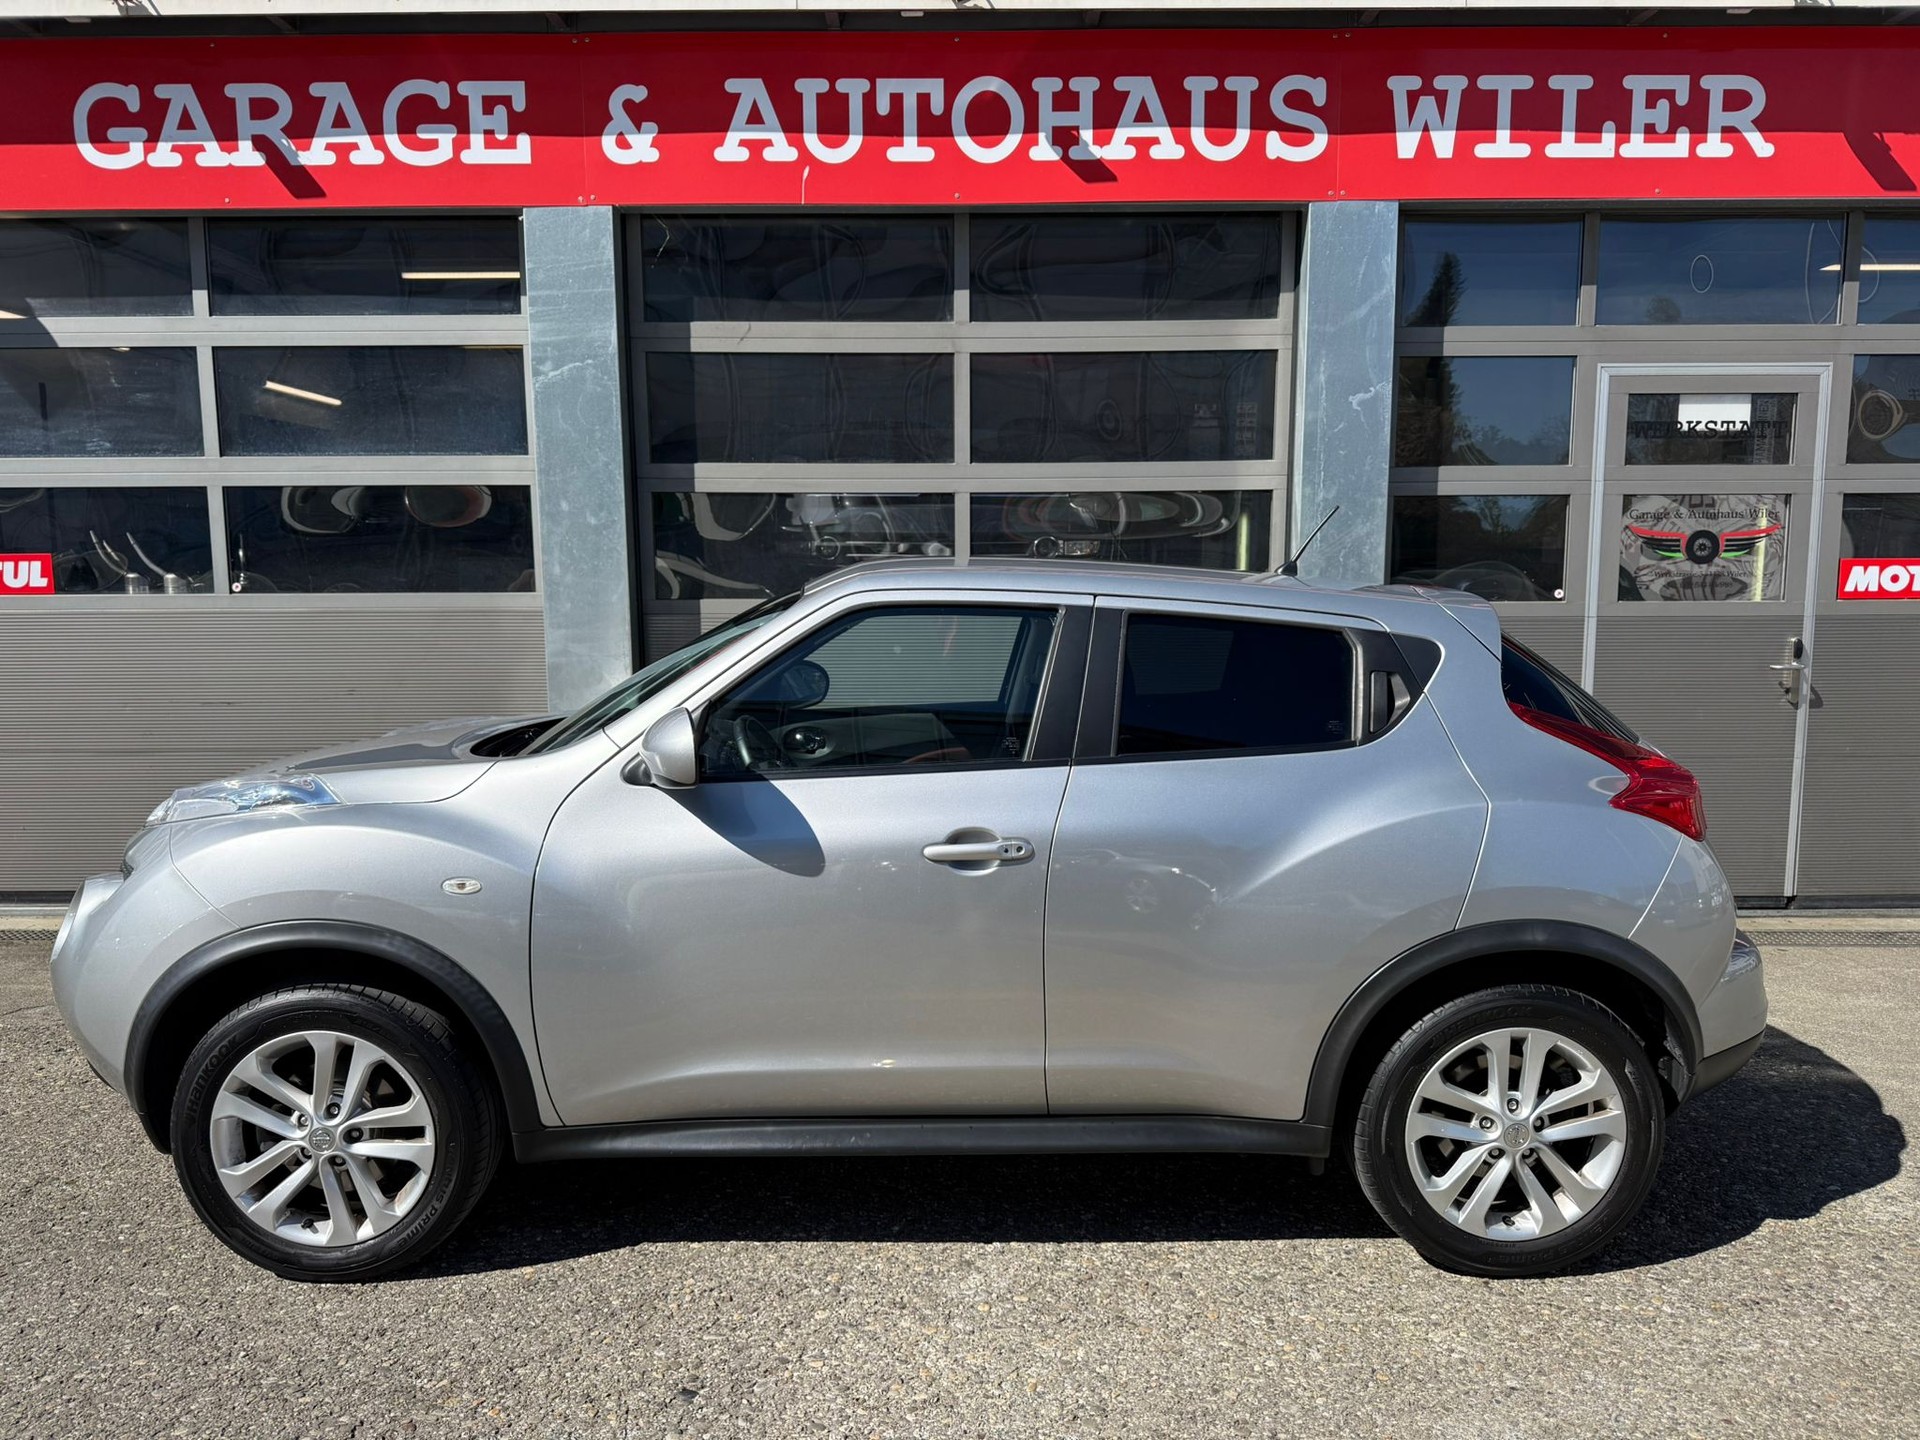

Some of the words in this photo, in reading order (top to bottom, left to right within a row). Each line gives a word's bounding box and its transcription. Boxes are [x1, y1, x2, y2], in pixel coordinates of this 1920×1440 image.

[73, 80, 532, 170] GARAGE
[601, 84, 660, 165] &
[713, 75, 1328, 165] AUTOHAUS
[1386, 74, 1776, 160] WILER
[1633, 420, 1788, 439] WERKSTATT
[1629, 509, 1670, 522] Garage
[1674, 510, 1684, 519] &
[1688, 509, 1744, 520] Autohaus
[1748, 508, 1780, 520] Wiler
[0, 560, 49, 588] UL
